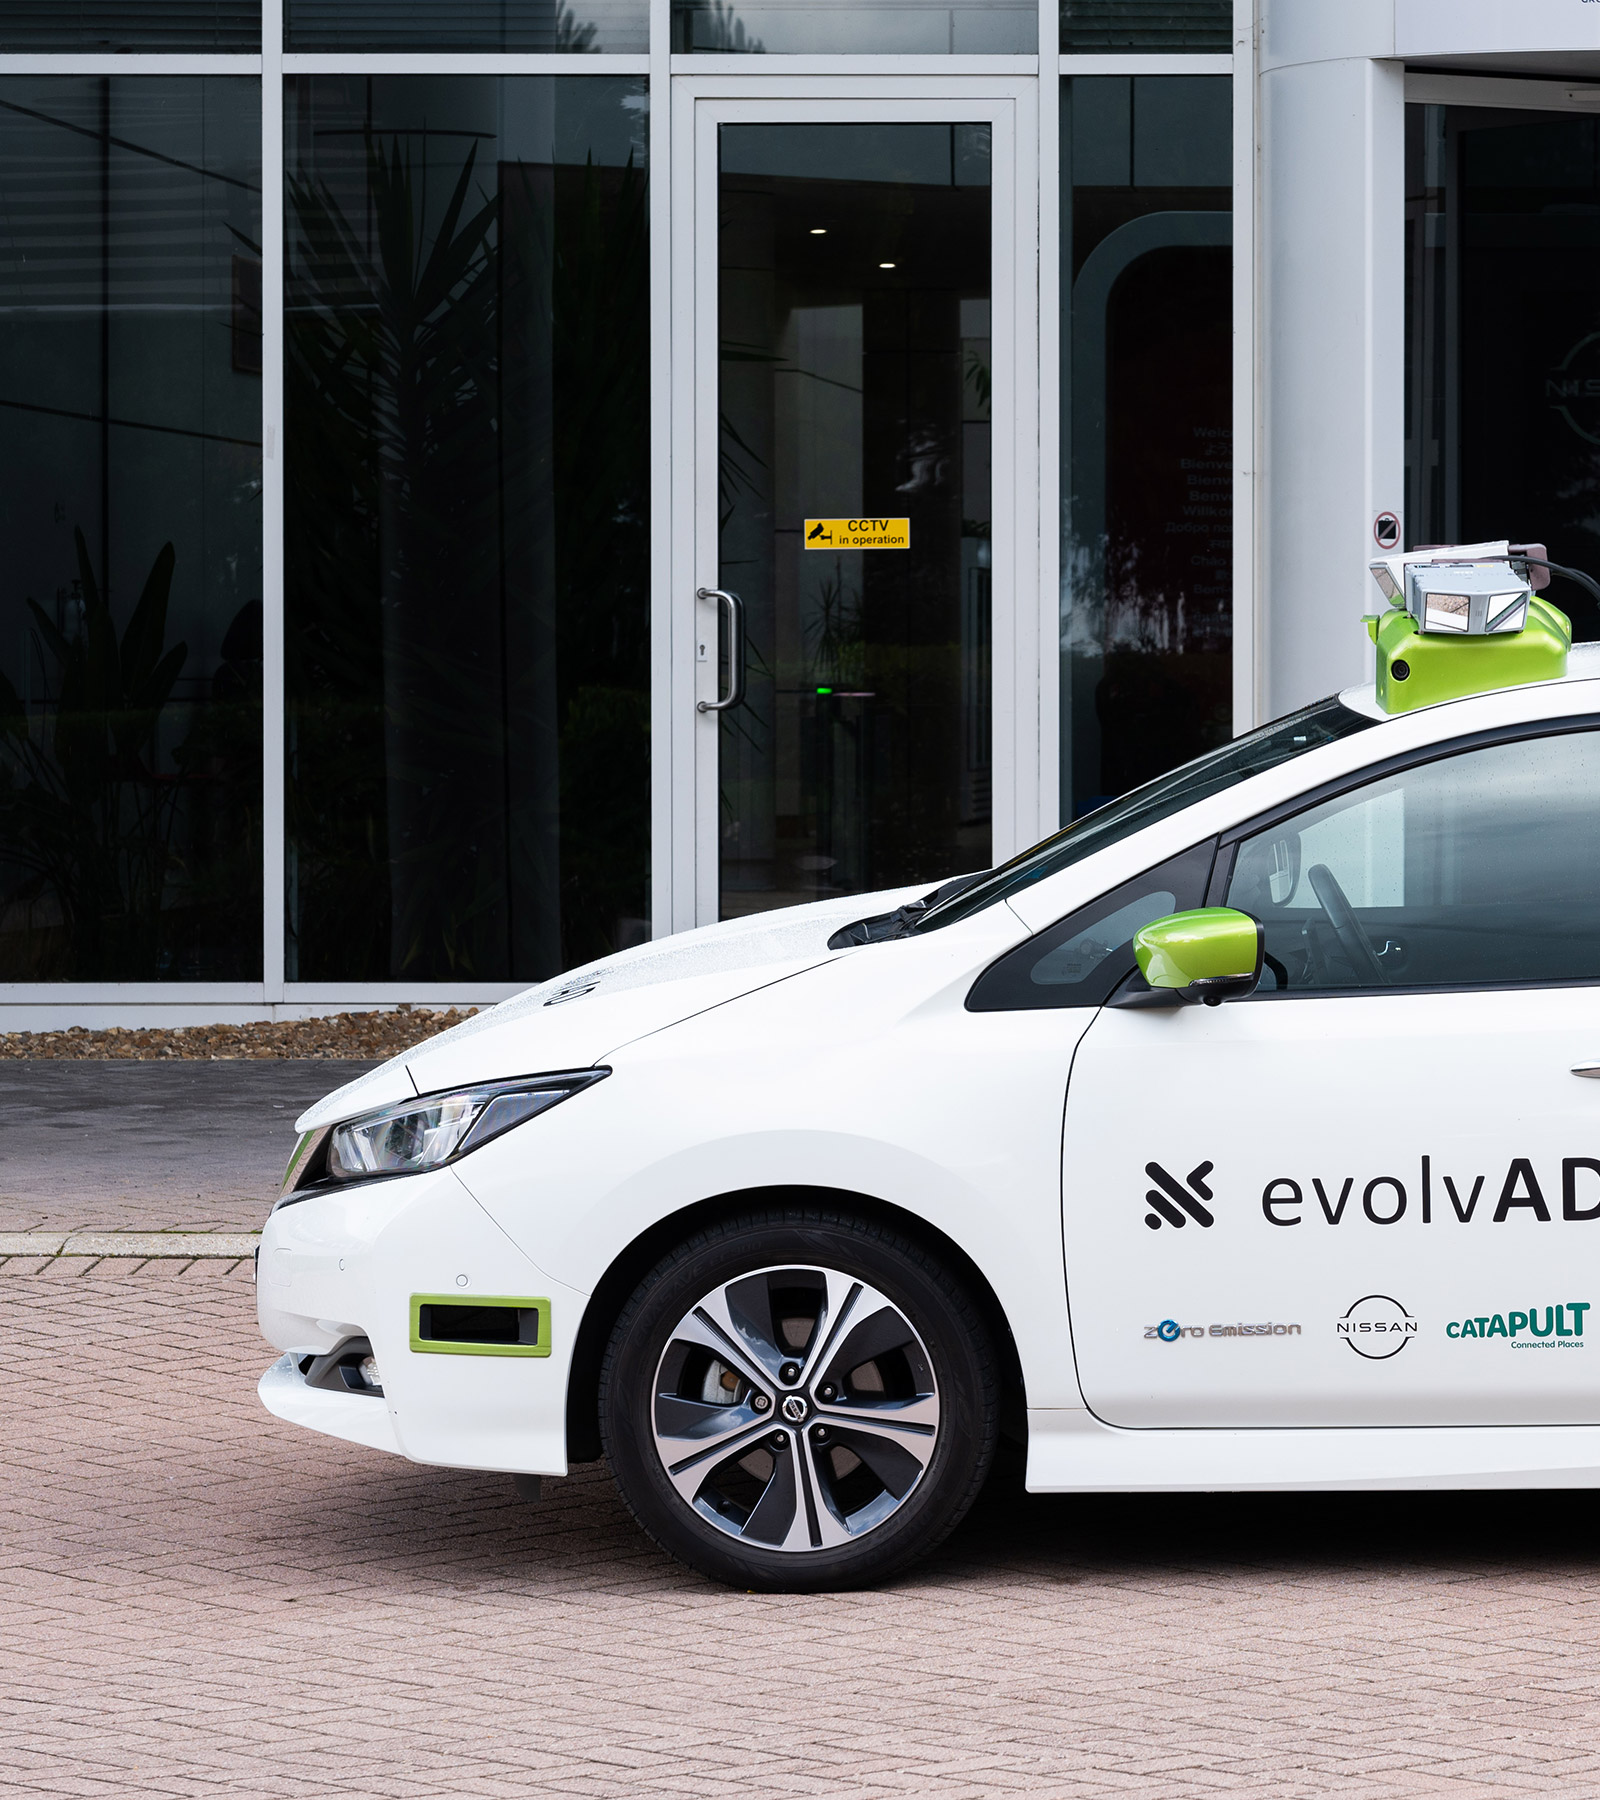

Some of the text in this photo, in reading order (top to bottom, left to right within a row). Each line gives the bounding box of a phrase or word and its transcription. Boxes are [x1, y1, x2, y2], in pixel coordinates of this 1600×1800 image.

[1187, 474, 1232, 485] Bienv
[848, 520, 889, 532] CCTV
[839, 535, 904, 546] in operation
[1208, 1322, 1302, 1338] Emission
[1336, 1321, 1418, 1333] NISSAN
[1511, 1340, 1585, 1349] Connected Places
